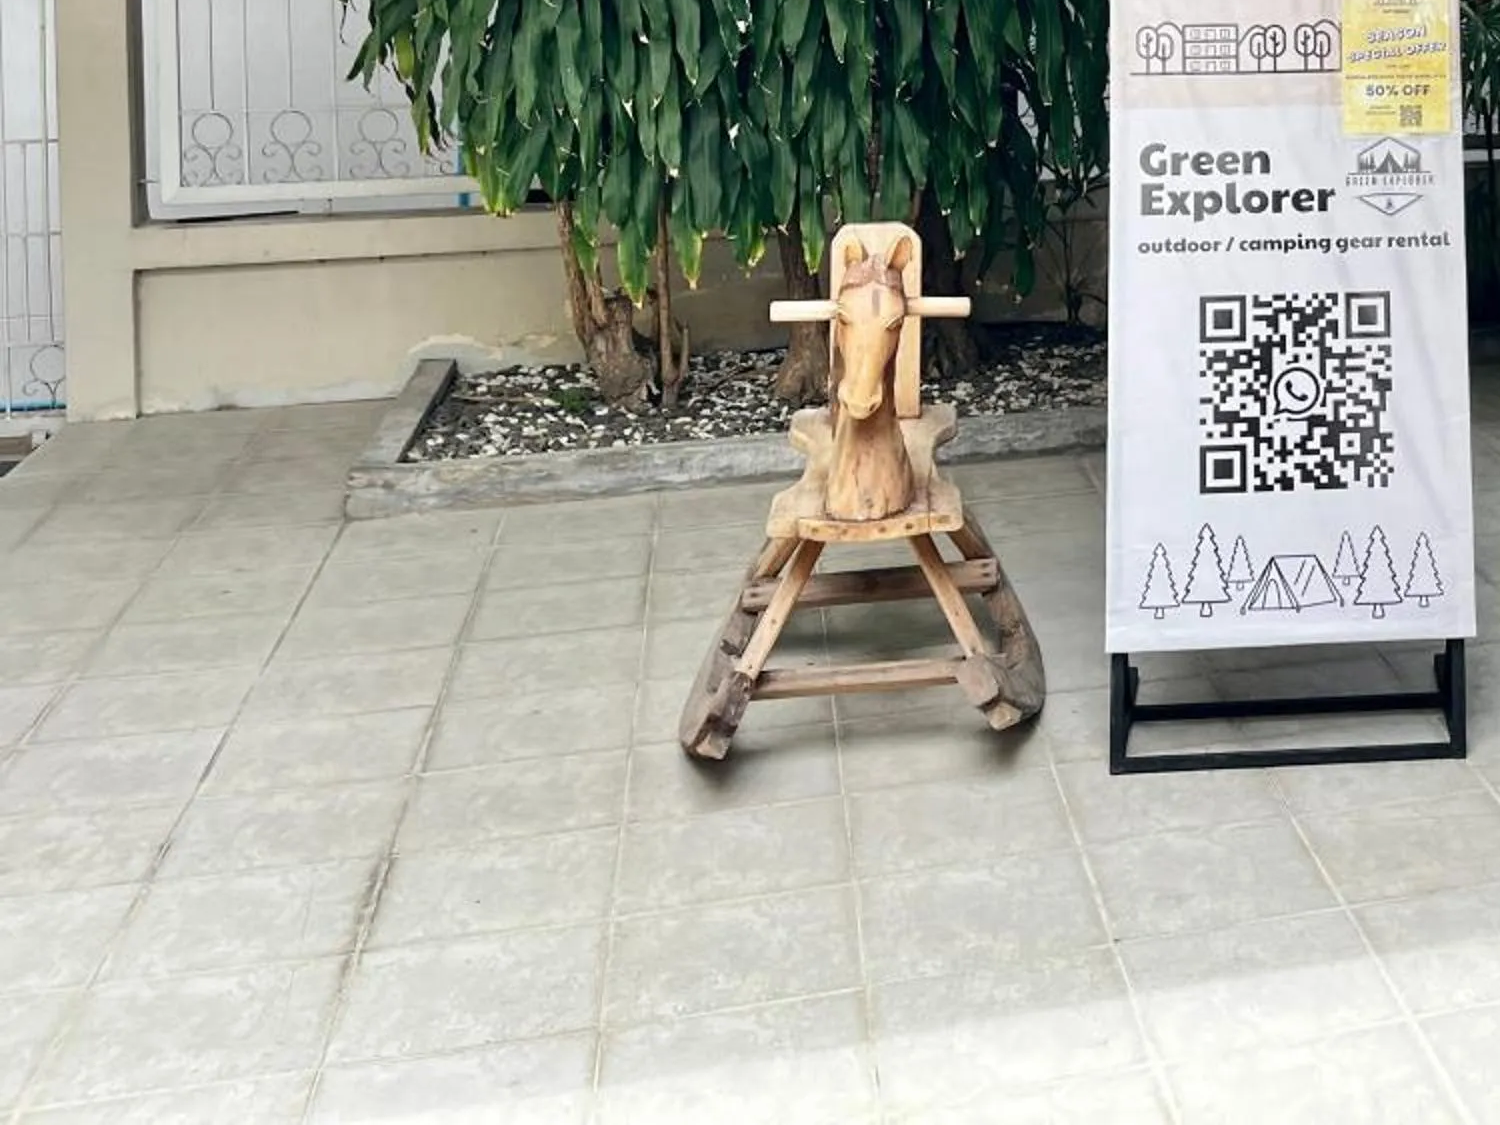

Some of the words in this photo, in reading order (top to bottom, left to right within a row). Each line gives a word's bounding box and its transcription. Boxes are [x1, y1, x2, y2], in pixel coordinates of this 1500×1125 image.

[1366, 84, 1399, 97] 50%
[1402, 84, 1431, 96] OFF
[1139, 142, 1271, 177] Green
[1140, 182, 1336, 222] Explorer
[1138, 236, 1222, 254] outdoor
[1225, 236, 1235, 253] /
[1239, 234, 1331, 254] camping
[1335, 235, 1383, 252] gear
[1387, 231, 1450, 248] rental
